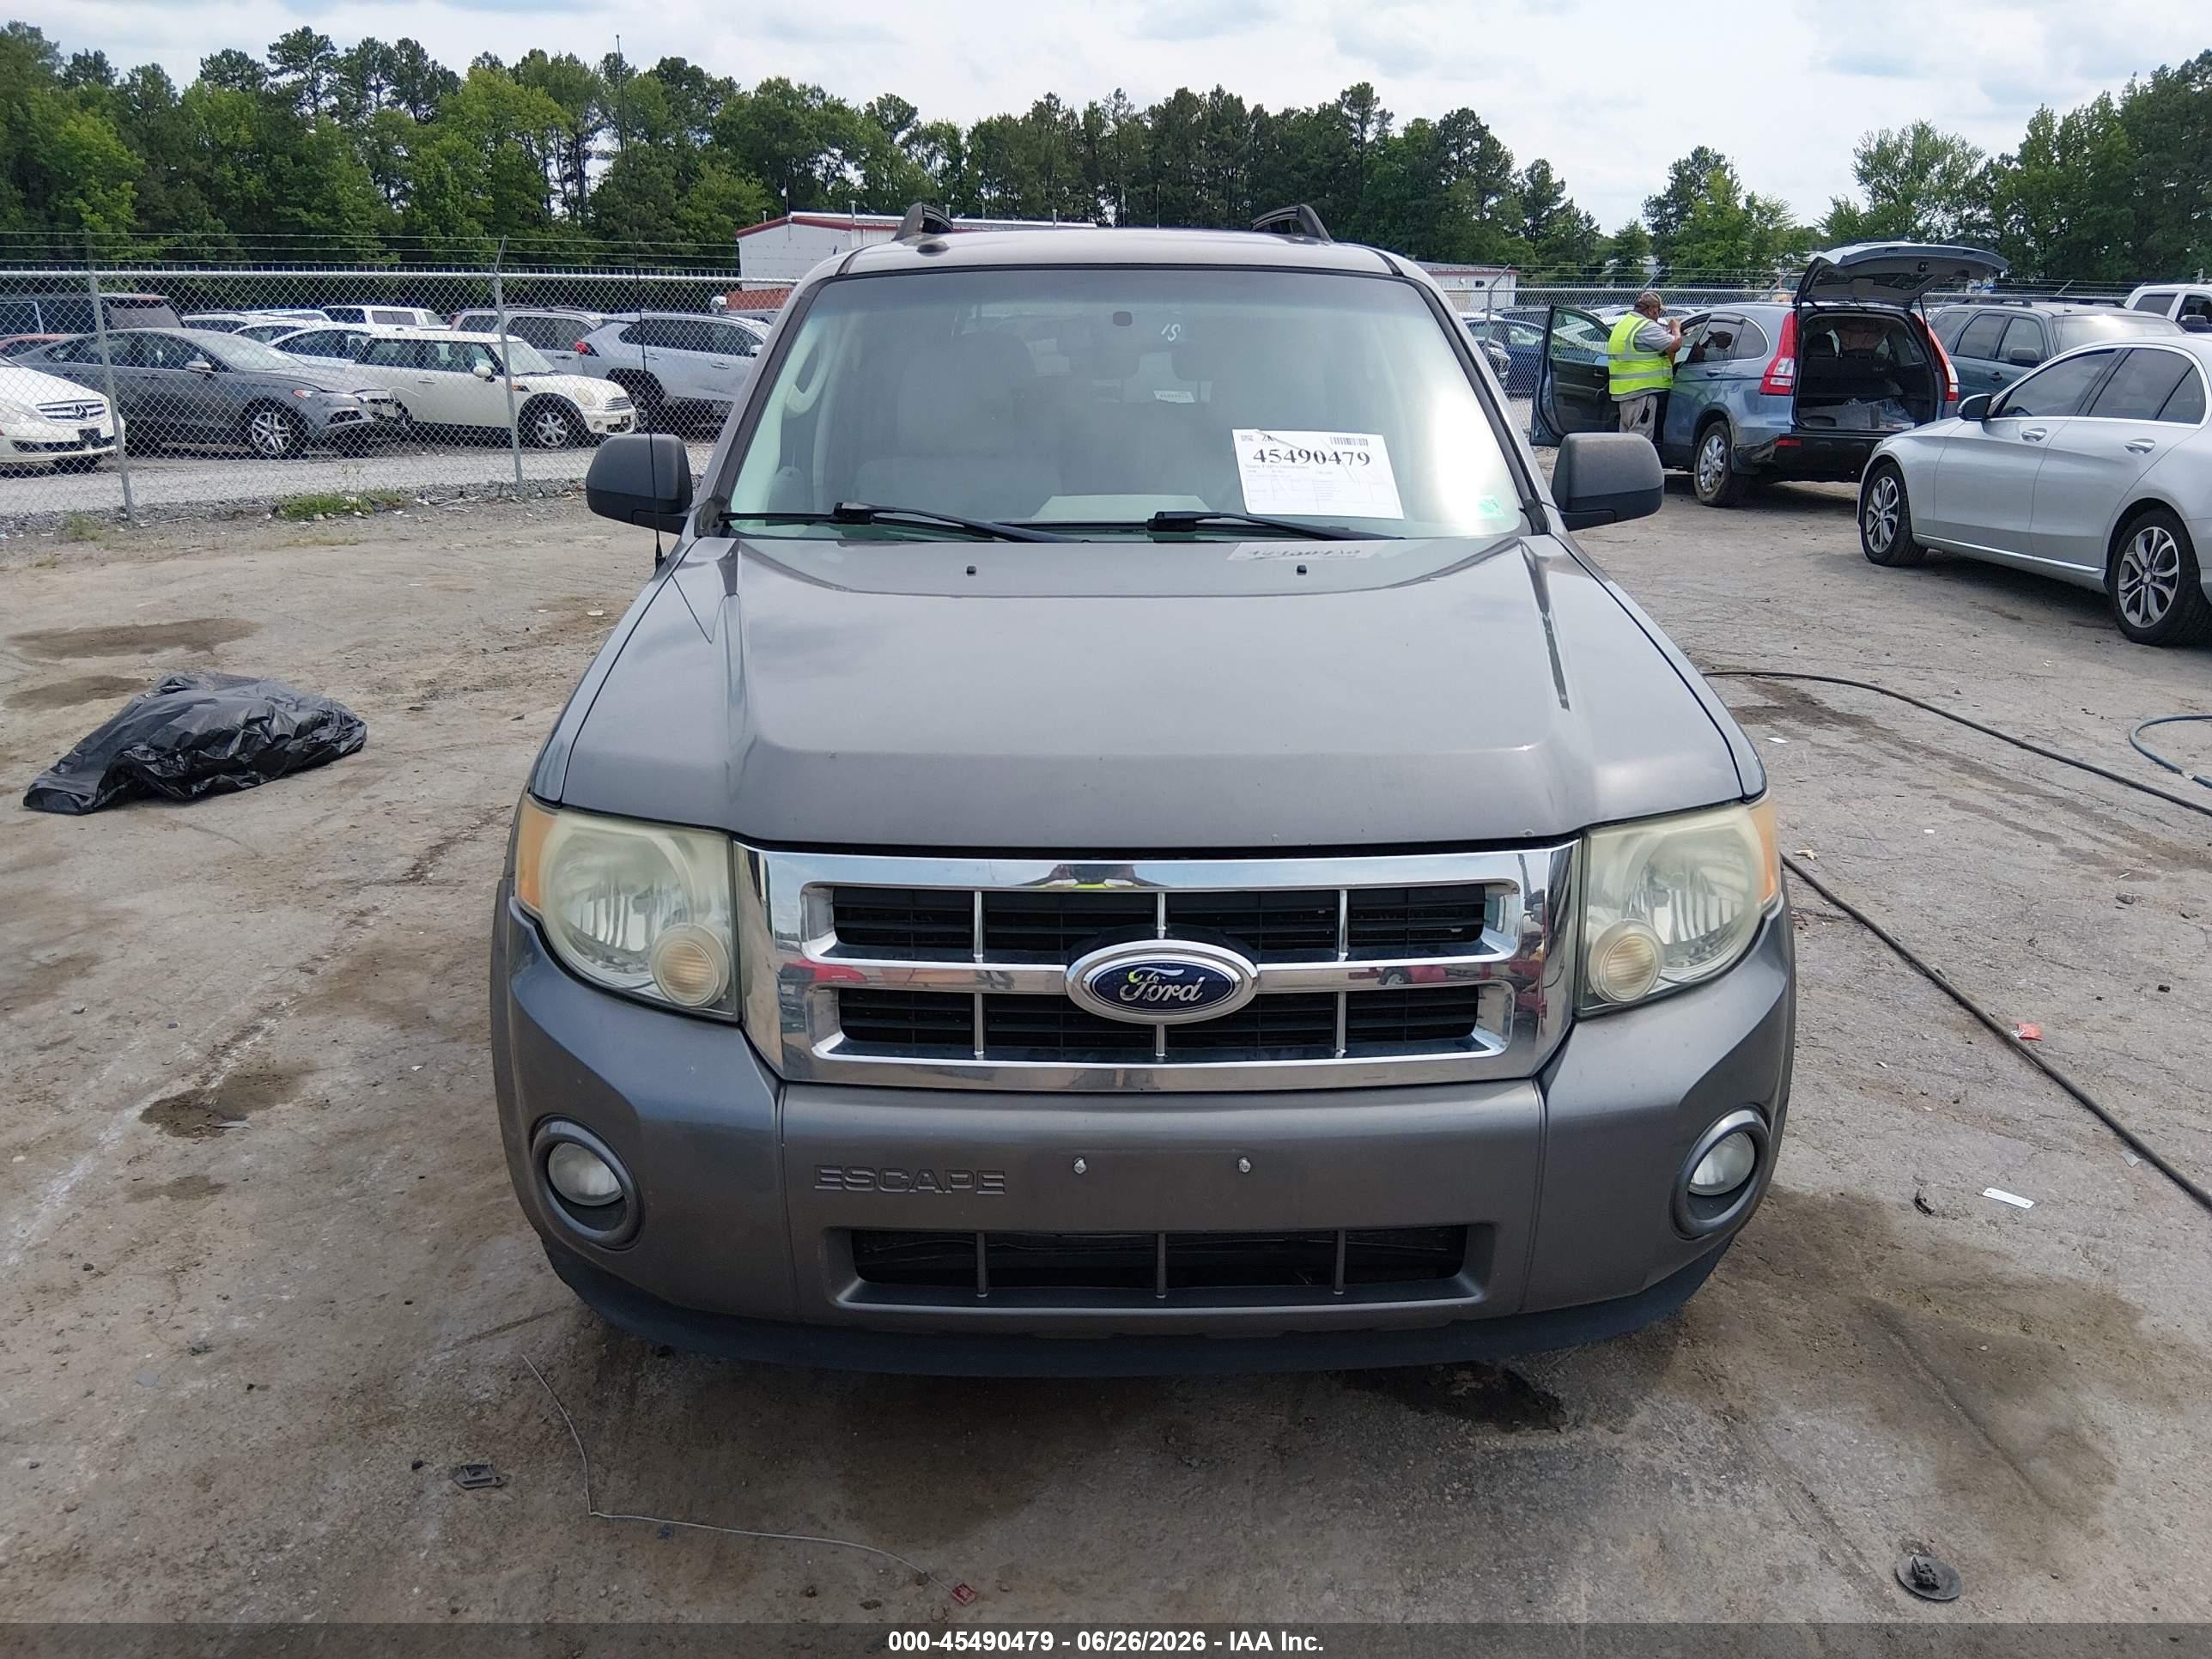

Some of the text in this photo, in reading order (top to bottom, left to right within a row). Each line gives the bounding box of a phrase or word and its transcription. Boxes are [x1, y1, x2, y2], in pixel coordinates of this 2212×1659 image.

[1252, 447, 1371, 467] 45490479
[1119, 965, 1206, 1003] Ford
[813, 1164, 1006, 1195] ESCAPE
